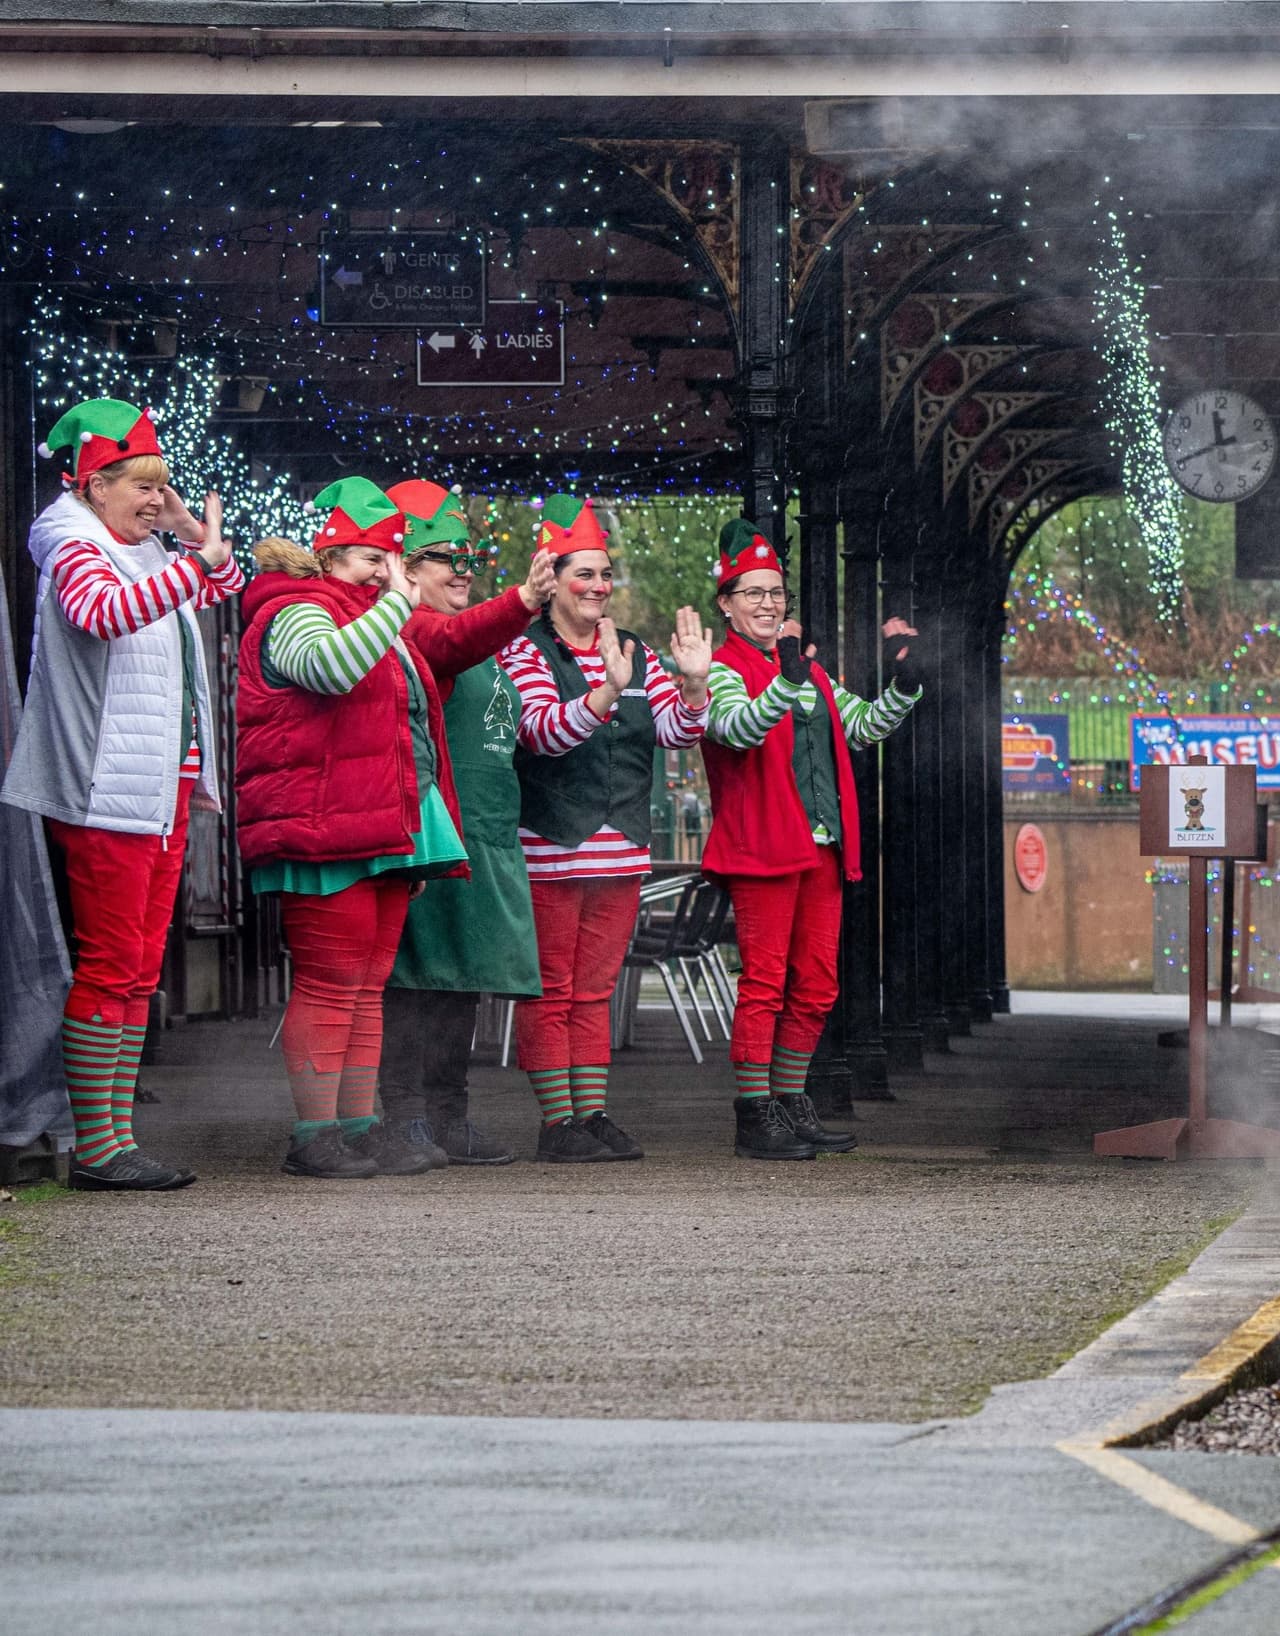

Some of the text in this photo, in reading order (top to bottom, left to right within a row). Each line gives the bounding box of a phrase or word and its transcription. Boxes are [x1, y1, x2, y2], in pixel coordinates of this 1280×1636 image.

[406, 253, 460, 267] GENTS
[395, 285, 473, 299] DISABLED
[496, 334, 552, 348] LADIES
[1196, 402, 1205, 416] 11
[1216, 397, 1227, 409] 12
[1253, 419, 1263, 432] 2
[1260, 440, 1269, 452] 3
[1252, 461, 1261, 471] 4
[1192, 473, 1203, 490] 7
[1215, 482, 1224, 494] 6
[1237, 475, 1246, 488] 5
[1177, 833, 1214, 841] BLITZEN
